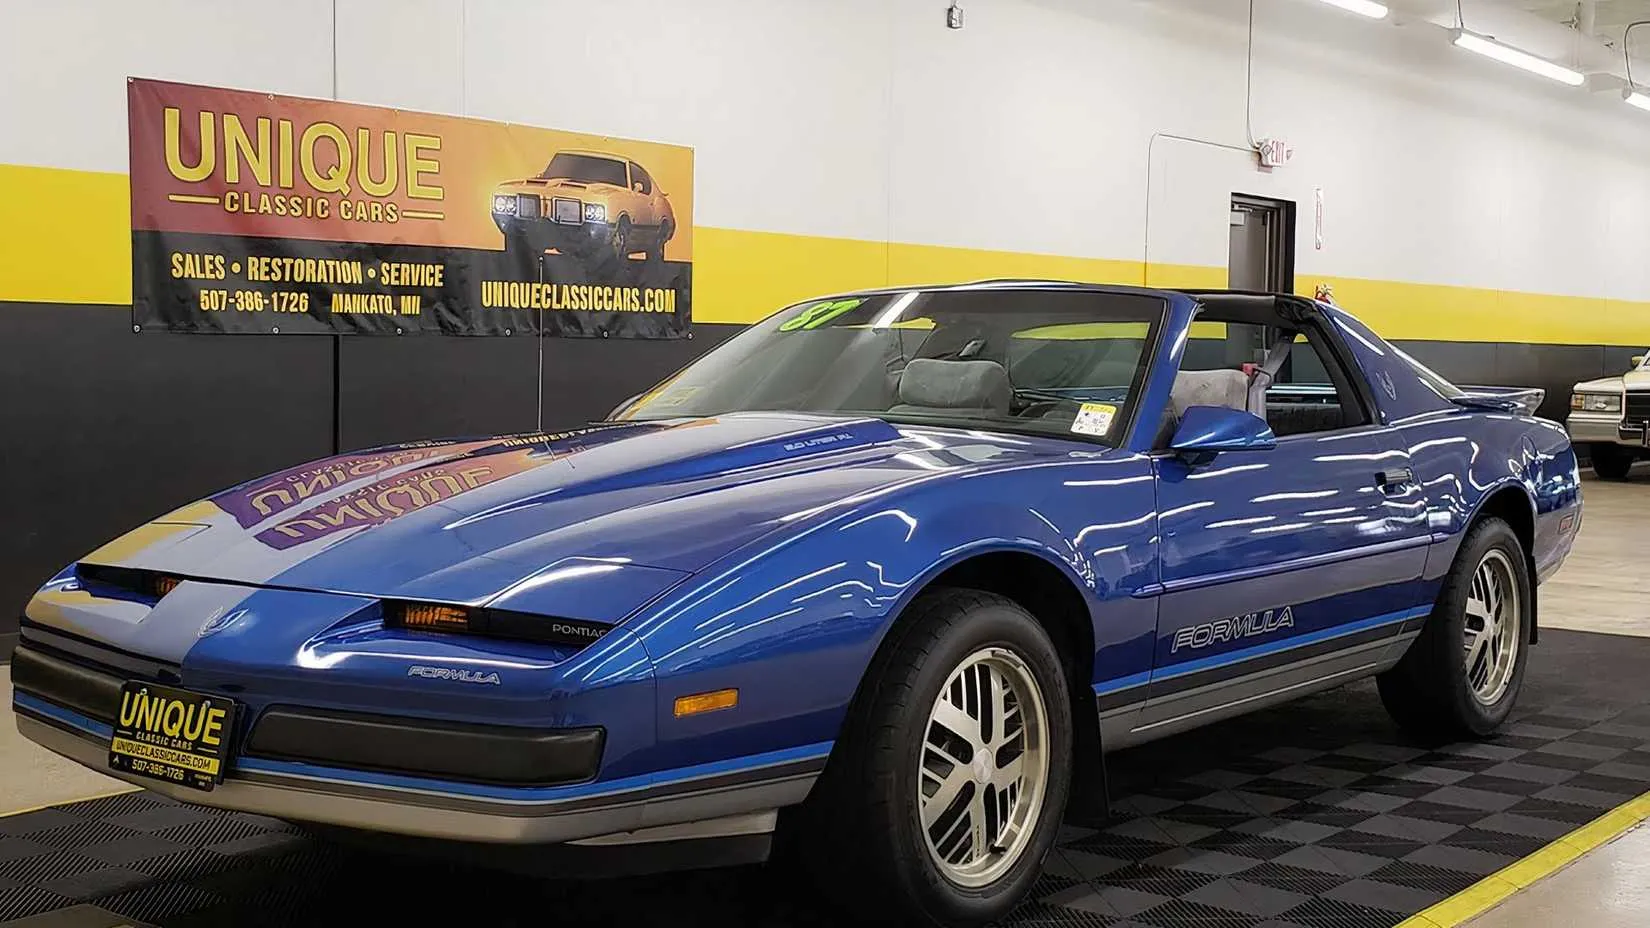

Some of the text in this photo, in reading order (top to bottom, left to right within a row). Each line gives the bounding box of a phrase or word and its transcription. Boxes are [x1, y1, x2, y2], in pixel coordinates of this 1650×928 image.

[163, 106, 445, 200] UNIQUE
[224, 191, 399, 223] CLASSIC CARS
[171, 252, 444, 288] SALES RESTORATION SERVICE
[199, 289, 309, 313] 507-386-1726
[331, 293, 397, 316] MANKATO,
[481, 280, 676, 313] UNIQUECLASSICCARS.COM
[1171, 605, 1295, 654] FORMULA
[407, 665, 501, 685] FORMULA
[119, 691, 226, 746] UNIQUE
[136, 731, 193, 751] CLASSIC CARS
